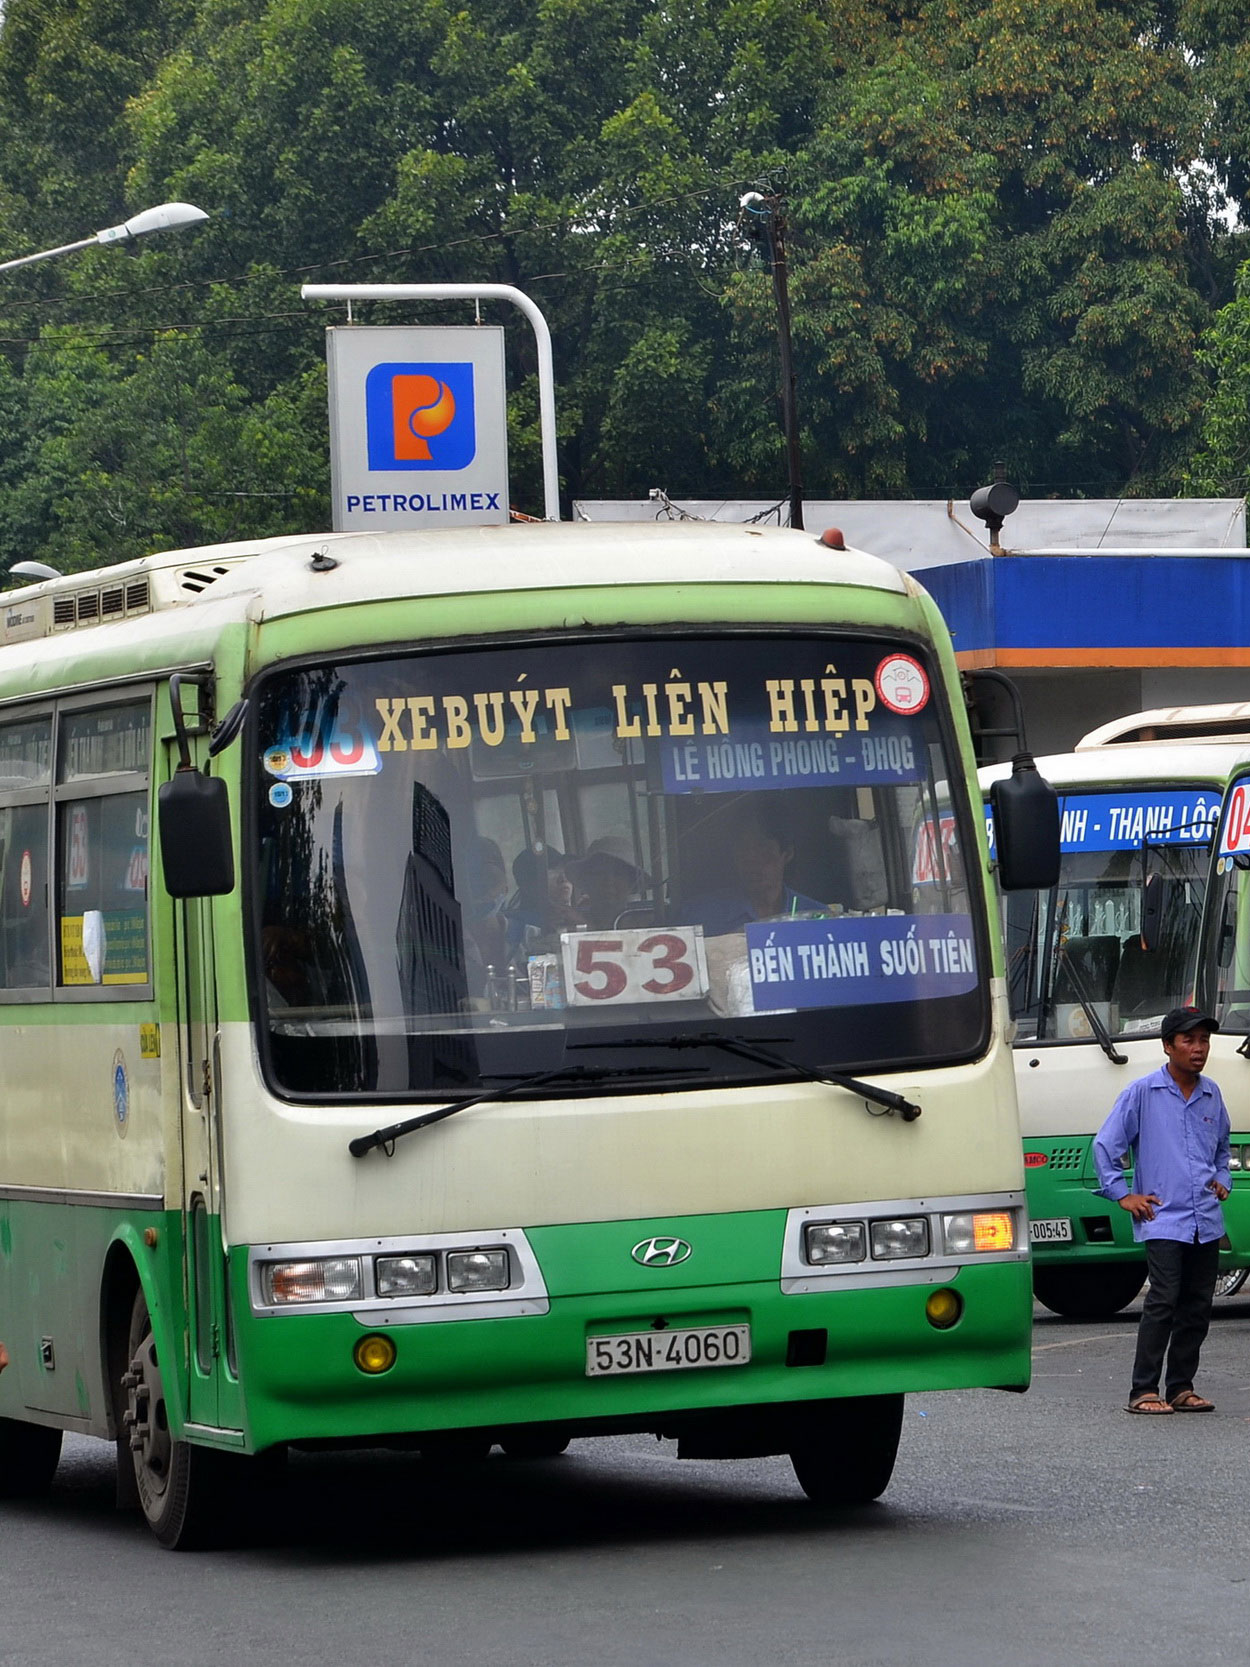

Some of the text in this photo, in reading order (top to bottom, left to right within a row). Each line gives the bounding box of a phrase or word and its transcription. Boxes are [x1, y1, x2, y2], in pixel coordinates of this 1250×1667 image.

[347, 493, 500, 512] PETROLIMEX
[612, 668, 729, 738] LIÊN
[766, 664, 876, 738] HIỆP
[1109, 805, 1173, 845] THẠNH
[573, 934, 694, 1000] 53
[750, 924, 974, 984] BẾN THÀNH SUỐI TIÊN
[1022, 1155, 1047, 1164] AMCO
[595, 1331, 739, 1371] 53N-4060
